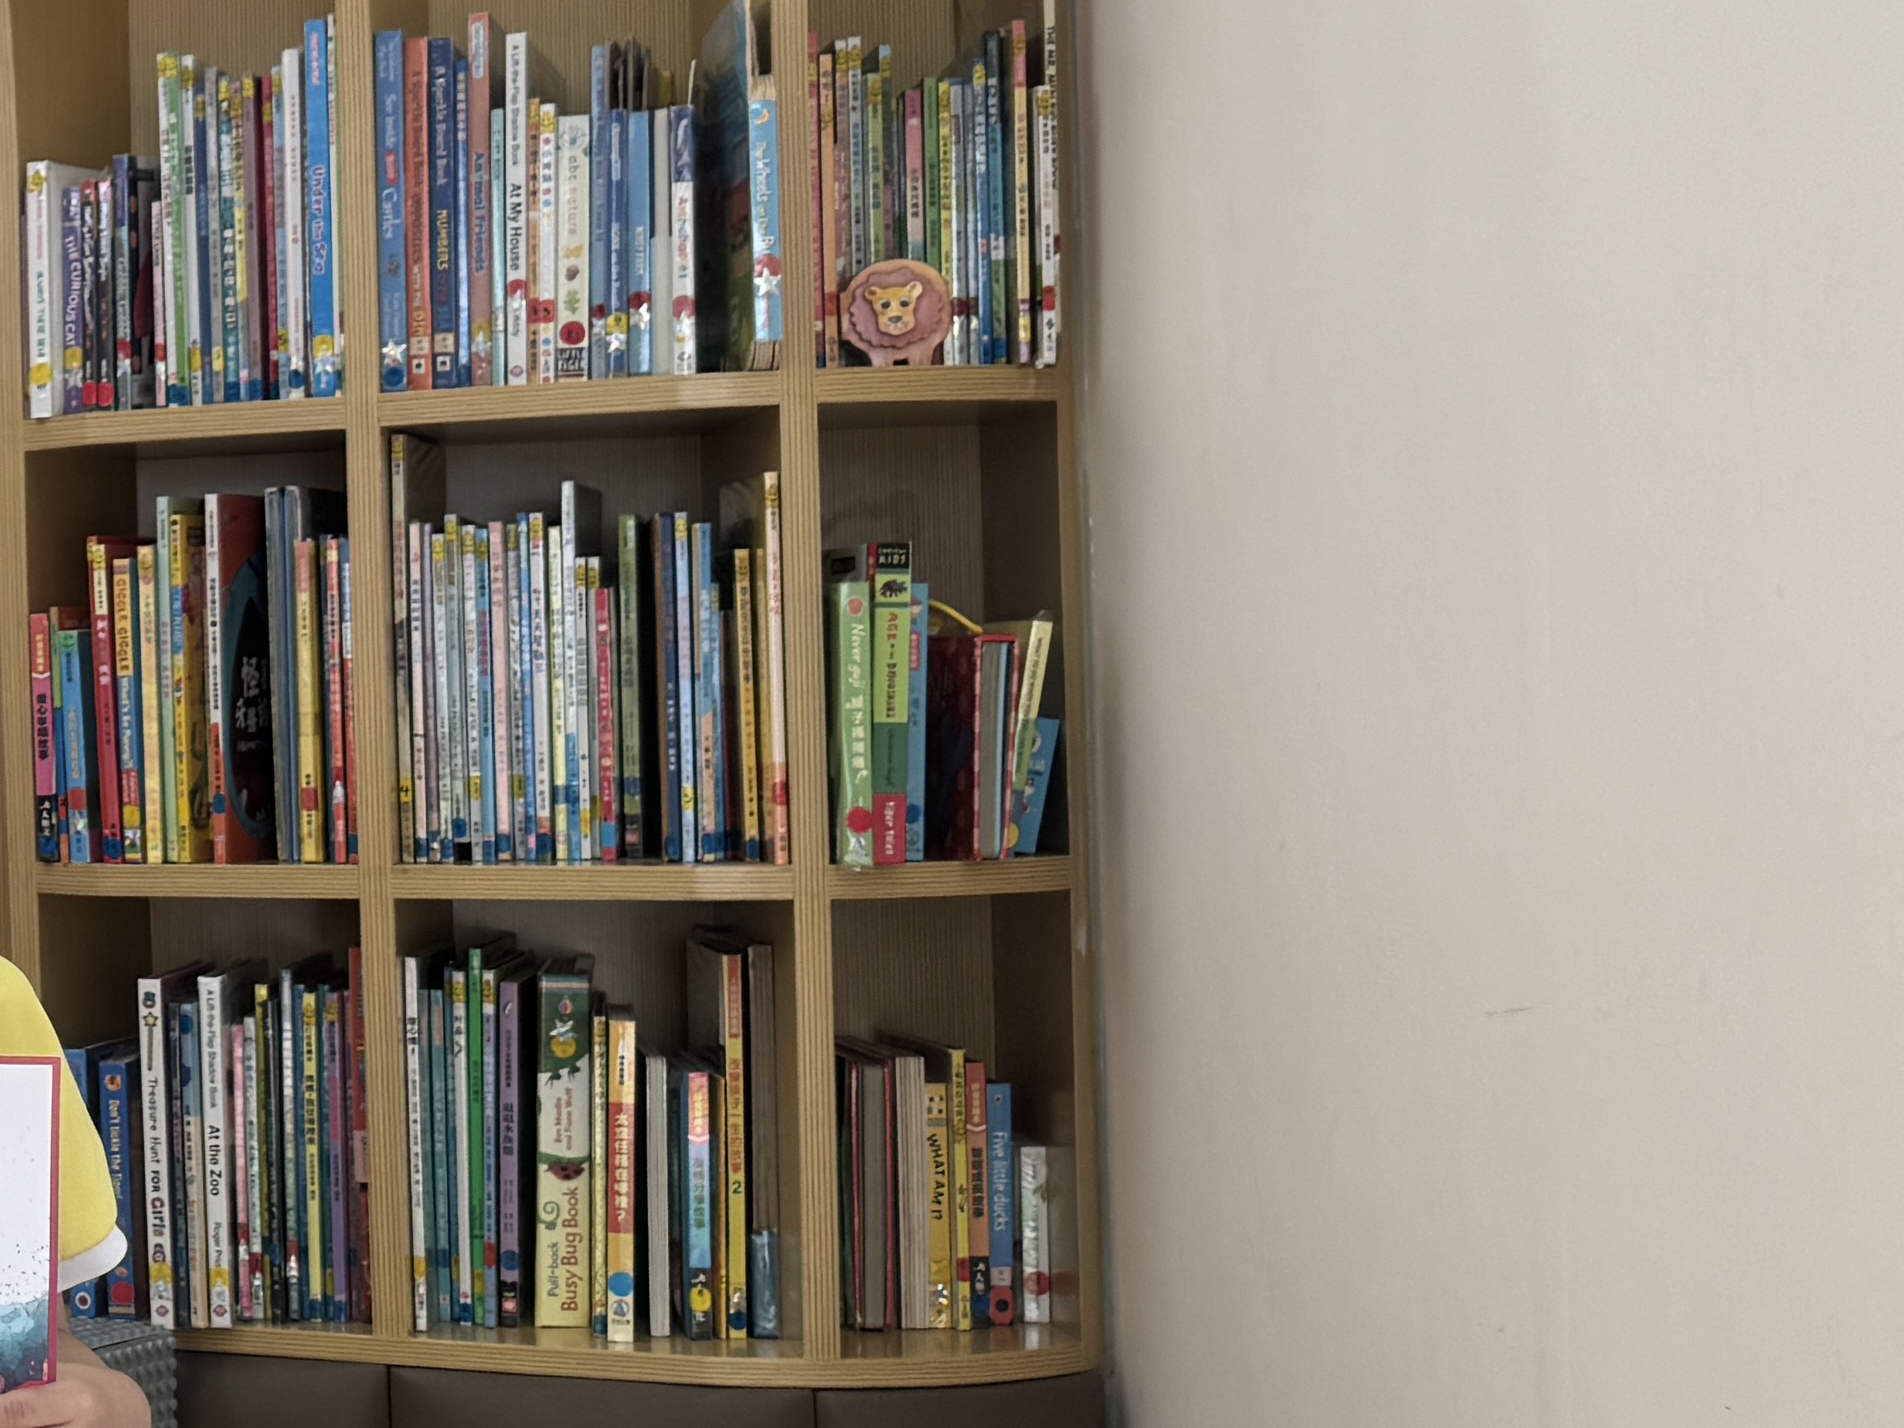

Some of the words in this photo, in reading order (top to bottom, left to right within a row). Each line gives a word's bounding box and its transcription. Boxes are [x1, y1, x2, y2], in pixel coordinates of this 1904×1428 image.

[509, 224, 522, 272] House
[147, 1076, 160, 1133] Treasure
[149, 1135, 161, 1168] Hunt
[926, 1132, 946, 1176] WHAT
[209, 1162, 221, 1197] Zoo
[562, 1186, 580, 1228] Book
[547, 1240, 560, 1299] Pull-back
[560, 1230, 584, 1268] Bug
[560, 1269, 584, 1313] Busy
